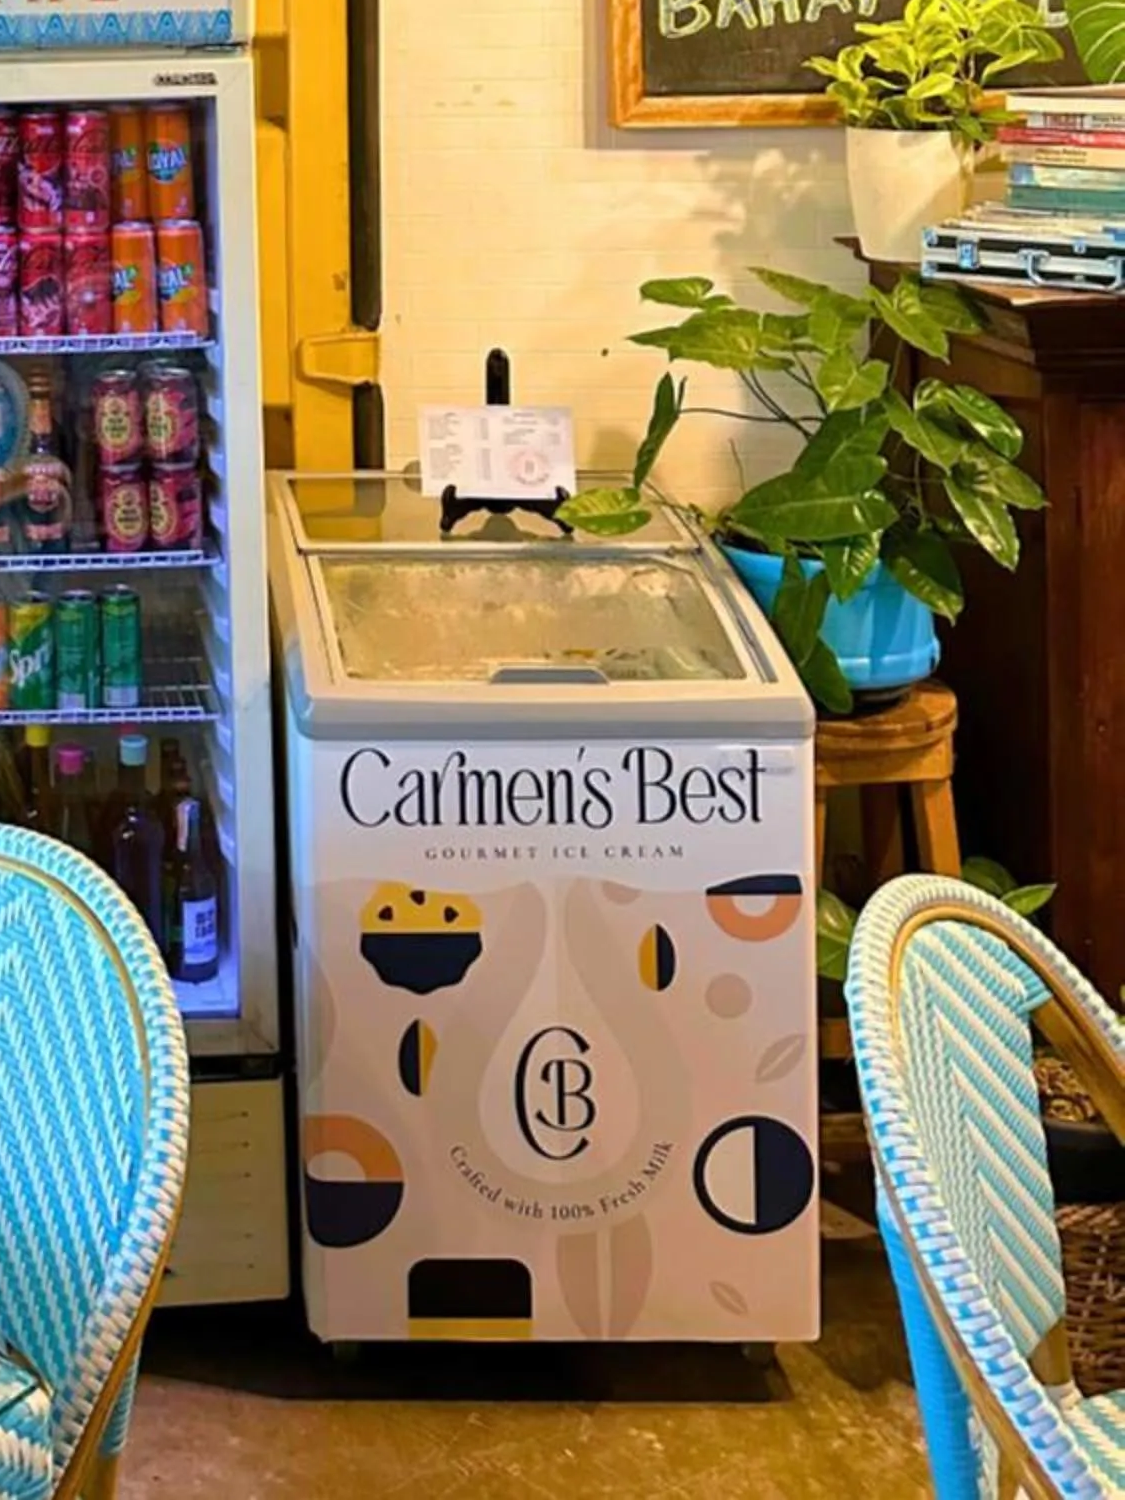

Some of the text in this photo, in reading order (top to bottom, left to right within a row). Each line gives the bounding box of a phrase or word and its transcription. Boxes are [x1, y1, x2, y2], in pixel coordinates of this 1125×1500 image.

[340, 745, 767, 830] Carmen's Best
[425, 845, 684, 860] GOURMET ICE CREAM
[449, 1141, 674, 1221] Crafted with 100% Fresh Milk
